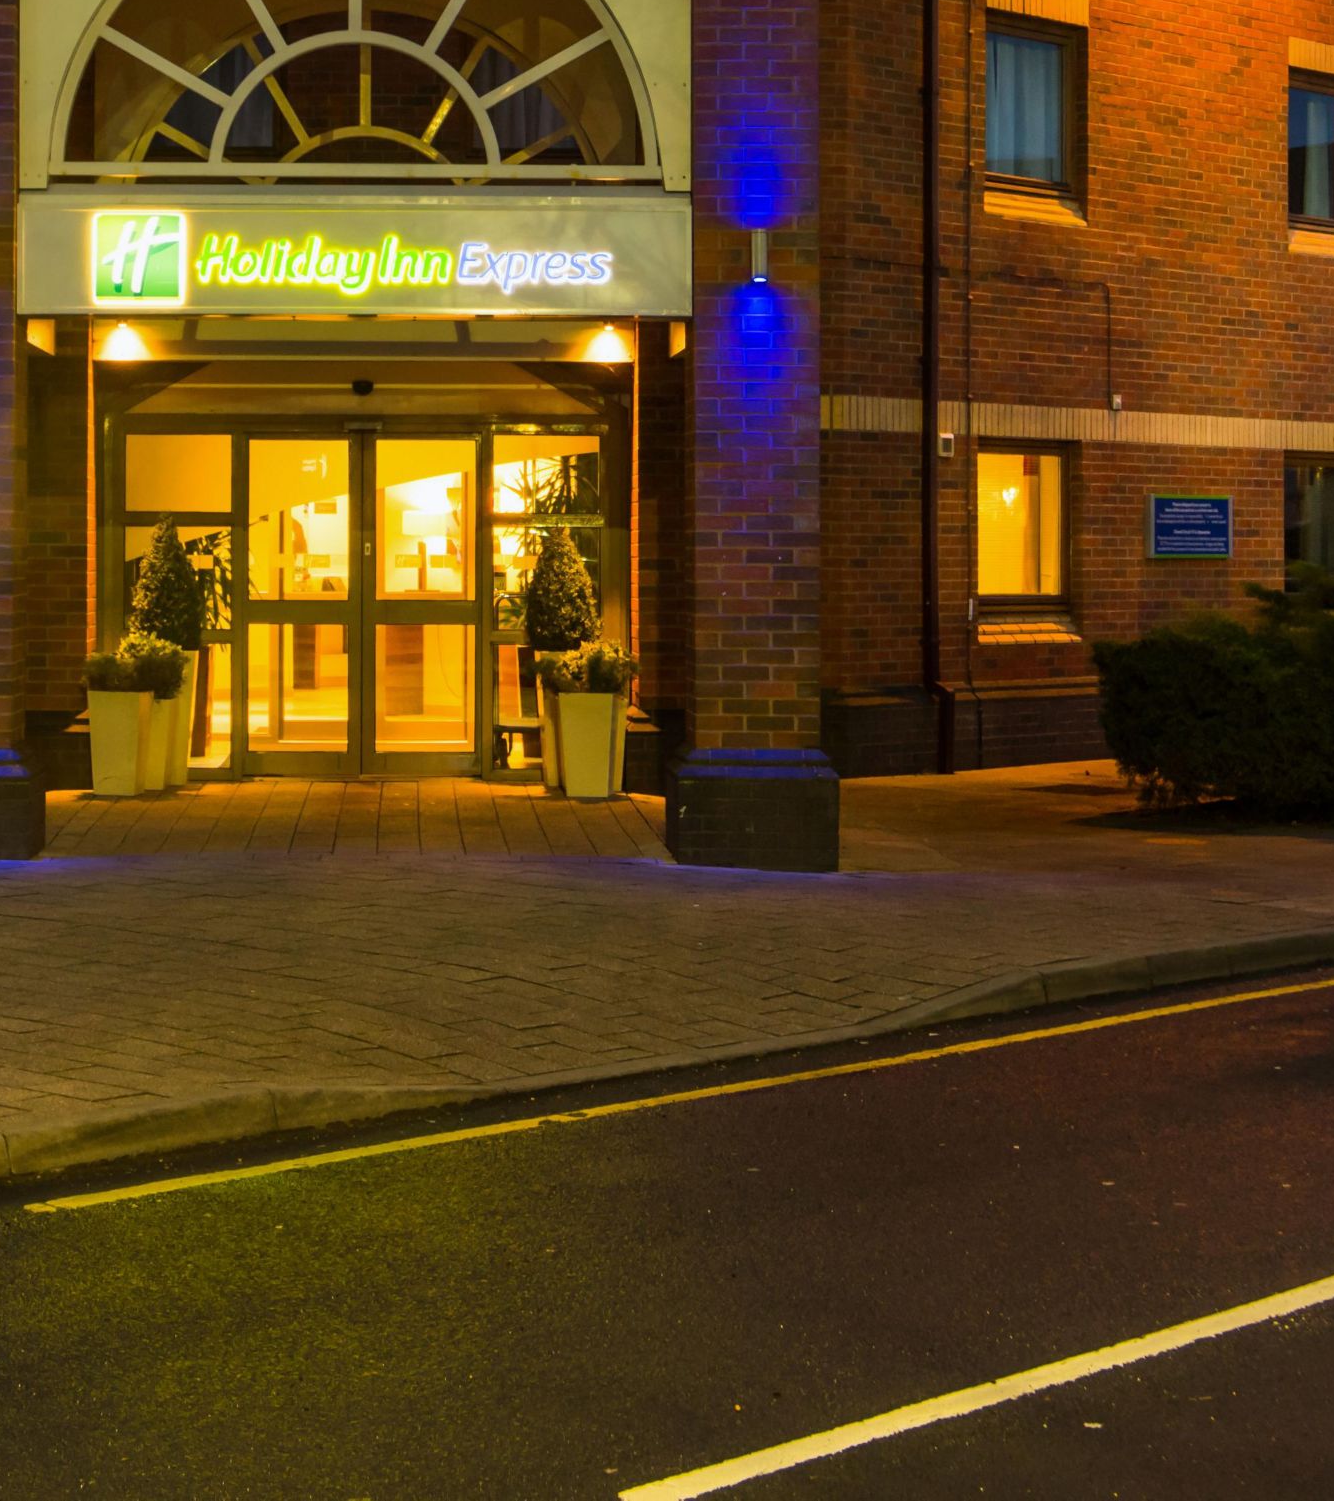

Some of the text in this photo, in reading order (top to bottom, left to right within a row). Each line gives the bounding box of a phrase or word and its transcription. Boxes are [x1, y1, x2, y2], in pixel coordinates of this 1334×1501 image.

[197, 235, 613, 294] Holiday Inn Express
